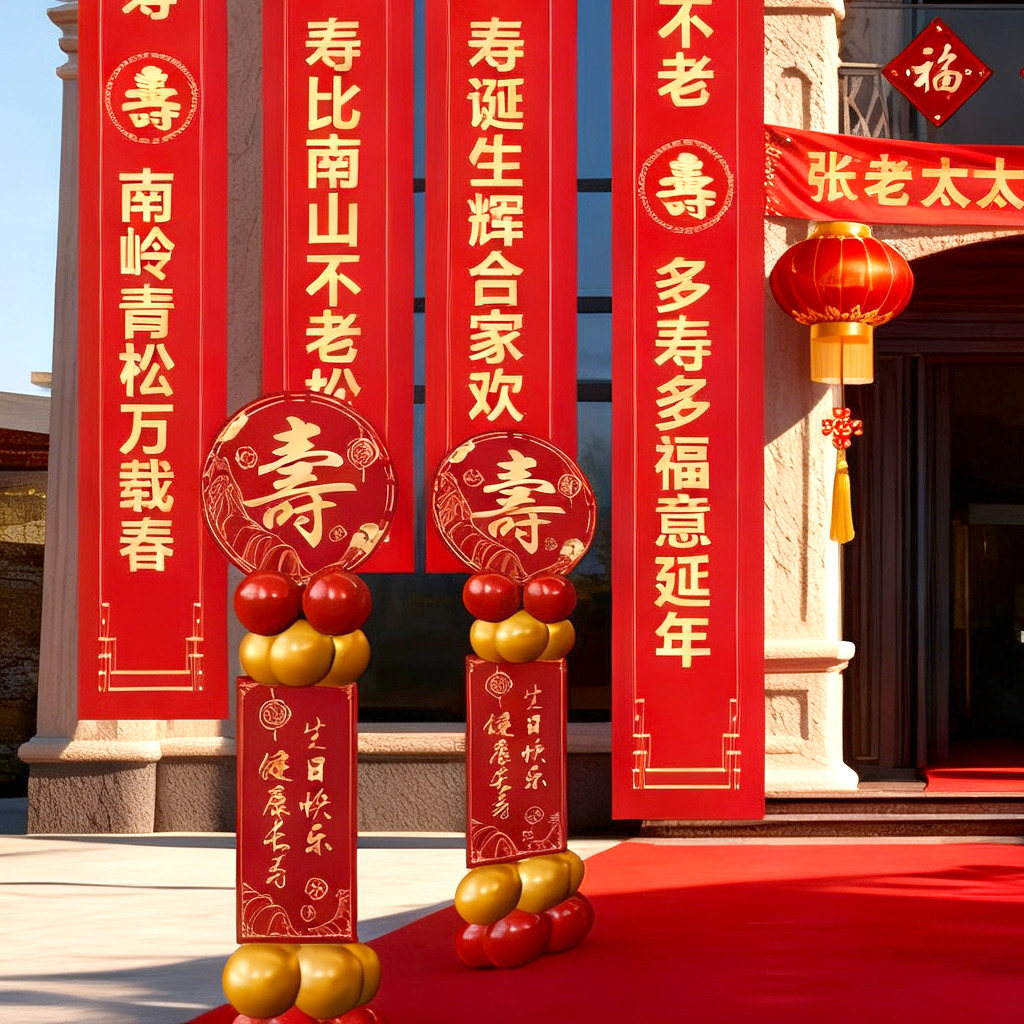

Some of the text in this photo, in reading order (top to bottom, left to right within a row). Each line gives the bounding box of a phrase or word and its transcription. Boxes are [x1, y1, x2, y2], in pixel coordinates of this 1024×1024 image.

[467, 17, 524, 421] 寿诞生辉合家欢
[912, 44, 962, 93] 福
[119, 168, 175, 571] 南岭青松万载春
[655, 257, 711, 667] 多寿多福意延年
